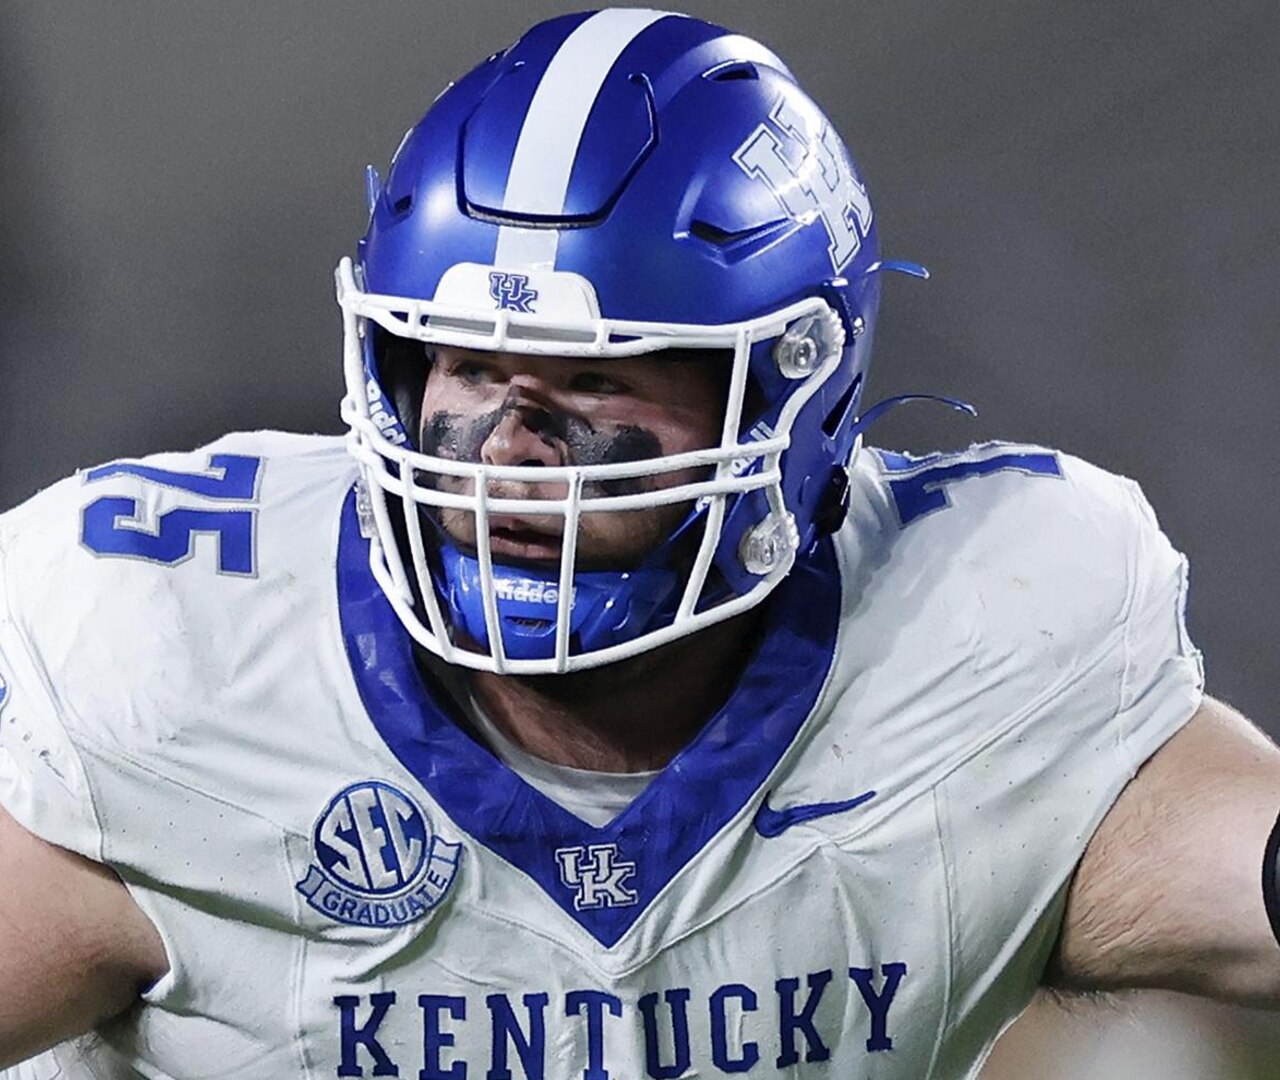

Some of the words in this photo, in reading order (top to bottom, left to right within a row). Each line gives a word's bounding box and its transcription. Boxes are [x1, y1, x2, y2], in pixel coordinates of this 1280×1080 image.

[488, 272, 538, 313] UK
[78, 453, 268, 578] 75
[320, 786, 422, 891] SEC
[323, 871, 448, 926] GRADUATE
[555, 843, 638, 911] UK
